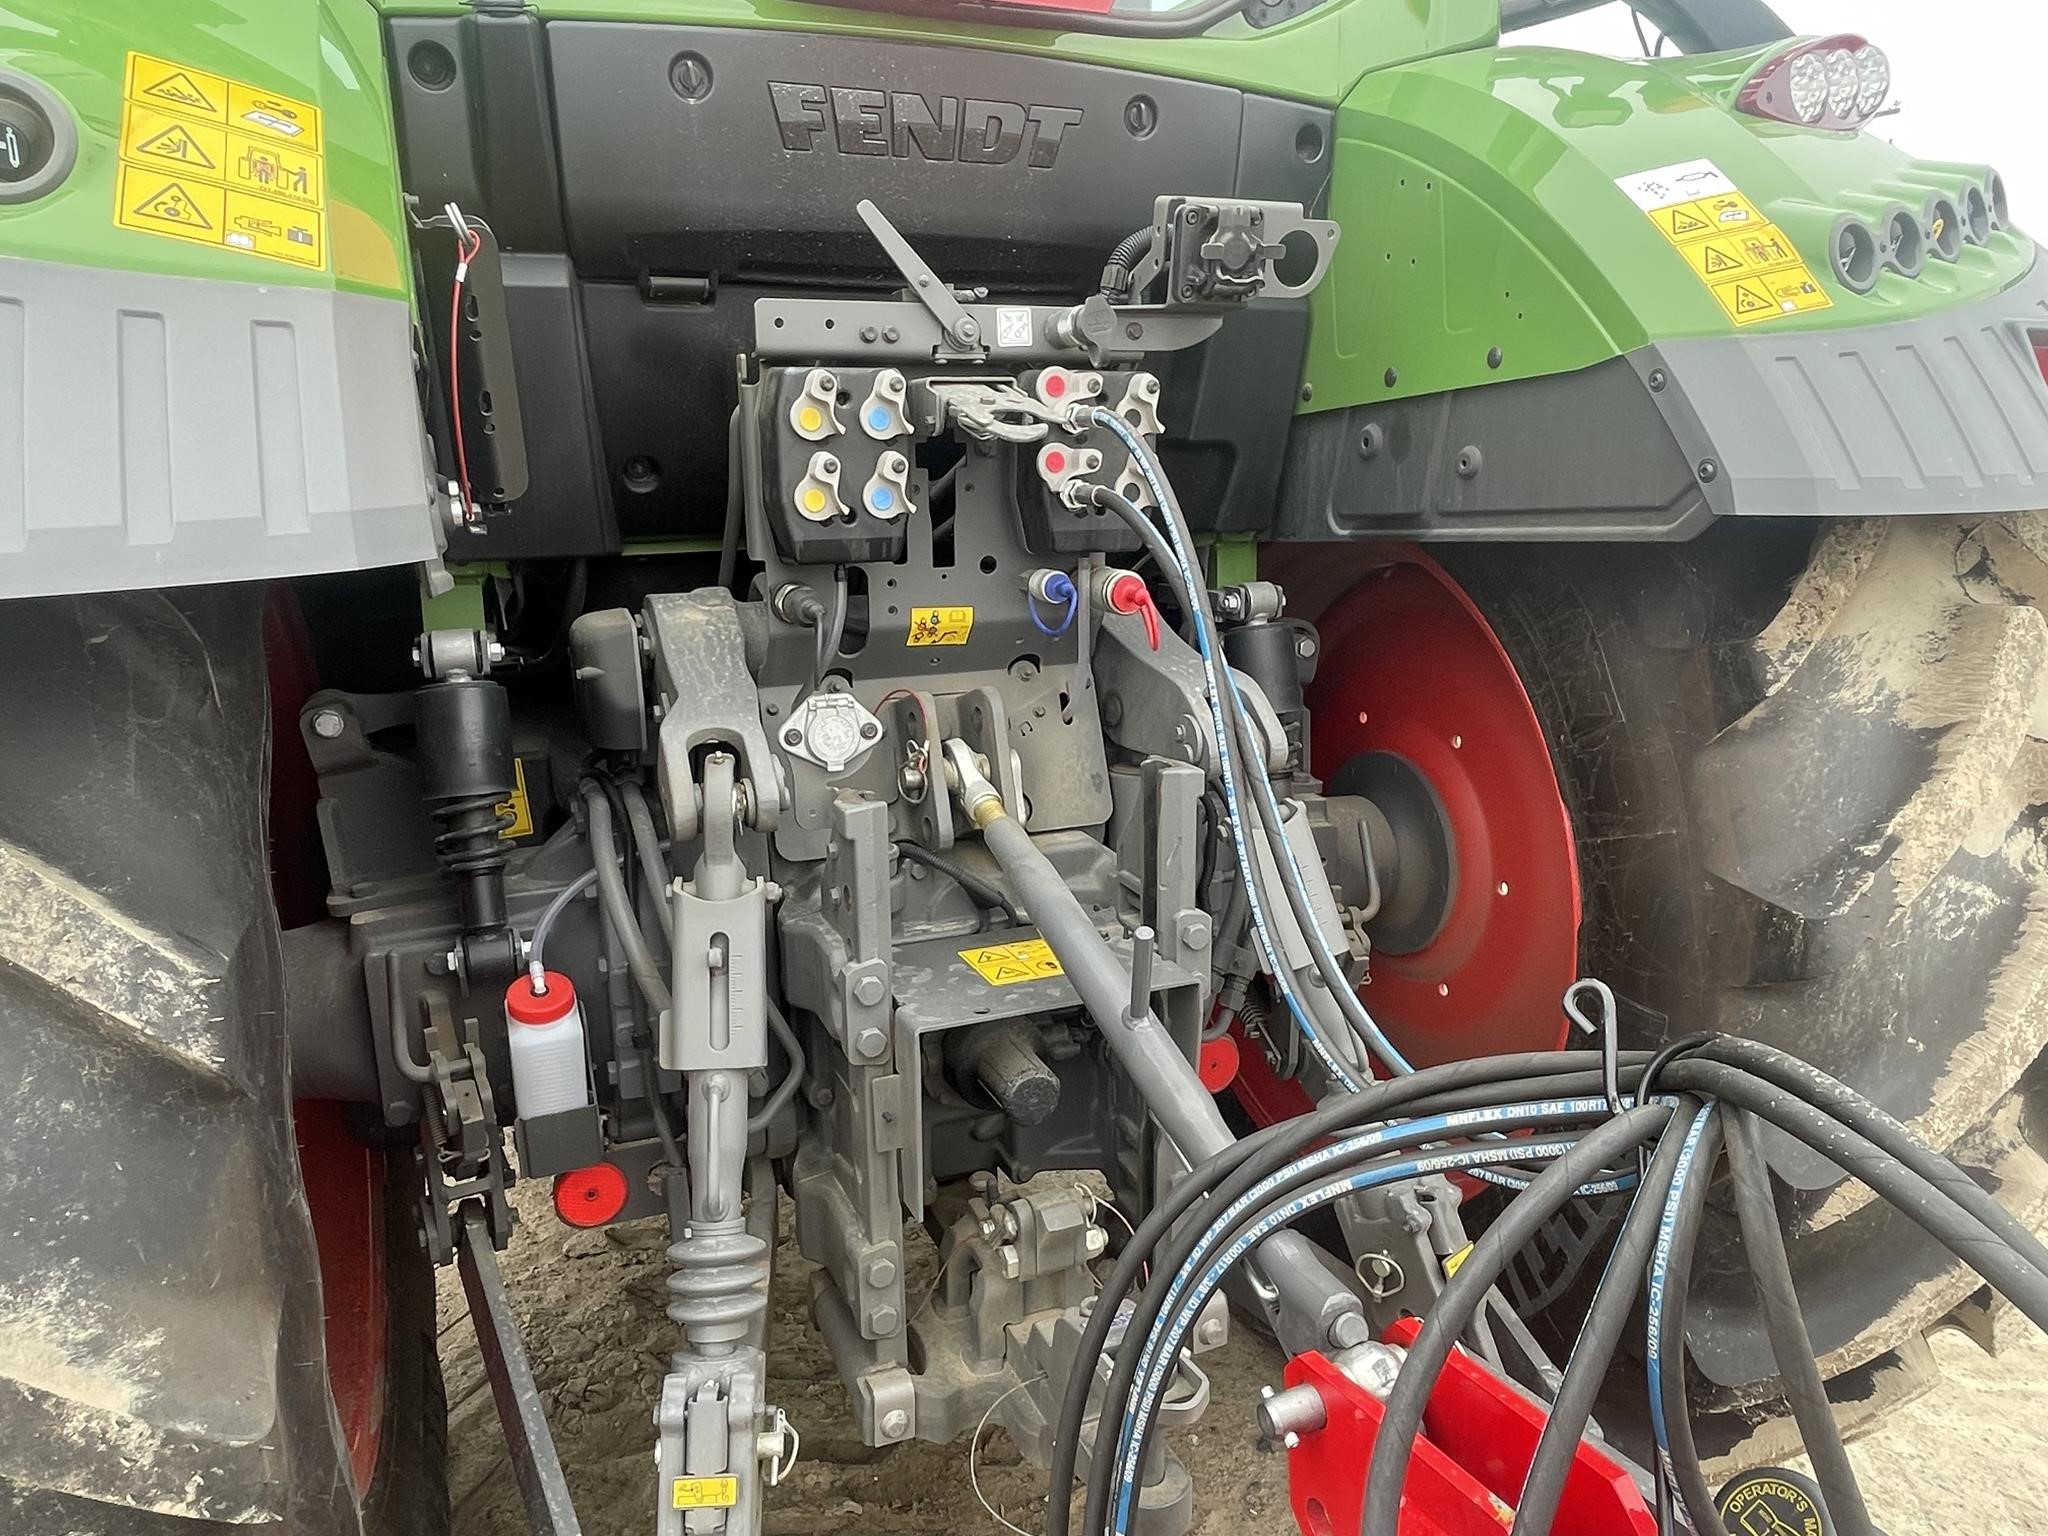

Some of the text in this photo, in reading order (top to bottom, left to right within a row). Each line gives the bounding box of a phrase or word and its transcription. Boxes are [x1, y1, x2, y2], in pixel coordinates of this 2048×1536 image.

[768, 80, 1084, 168] FENDT
[1312, 1038, 1345, 1078] MNFLEX
[1448, 1109, 1502, 1126] MNFLEX
[1508, 1104, 1537, 1118] DN10
[1542, 1102, 1565, 1114] SAE
[1417, 1154, 1469, 1172] IC-256/09
[1473, 1150, 1507, 1164] MSHA
[1510, 1148, 1532, 1160] PSI)
[1671, 1146, 1692, 1186] (3000
[1300, 1178, 1352, 1204] MNFLEX
[1485, 1171, 1506, 1187] BAR
[1269, 1205, 1296, 1225] DN10
[1662, 1189, 1681, 1224] PSI)
[1248, 1224, 1268, 1242] SAE
[1141, 1343, 1153, 1368] DN10
[1149, 1321, 1162, 1342] SAE
[1160, 1282, 1179, 1318] 100R17
[1192, 1247, 1203, 1259] ID
[1199, 1231, 1214, 1247] WP
[1212, 1215, 1229, 1232] 207
[1227, 1197, 1250, 1217] BAR
[1246, 1177, 1275, 1199] (3000
[1297, 1149, 1332, 1170] MSHA
[1216, 1241, 1247, 1274] 100R17
[1652, 1225, 1672, 1277] MSHA
[1189, 1297, 1200, 1310] ID
[1178, 1308, 1193, 1326] WP
[1646, 1281, 1662, 1360] IC-256/09
[1168, 1326, 1183, 1344] 207
[1157, 1343, 1175, 1366] BAR
[1146, 1364, 1165, 1391] (3000
[1139, 1391, 1155, 1412] PSI)
[1132, 1410, 1148, 1439] MSHA
[1730, 1483, 1808, 1512] OPERATOR'S
